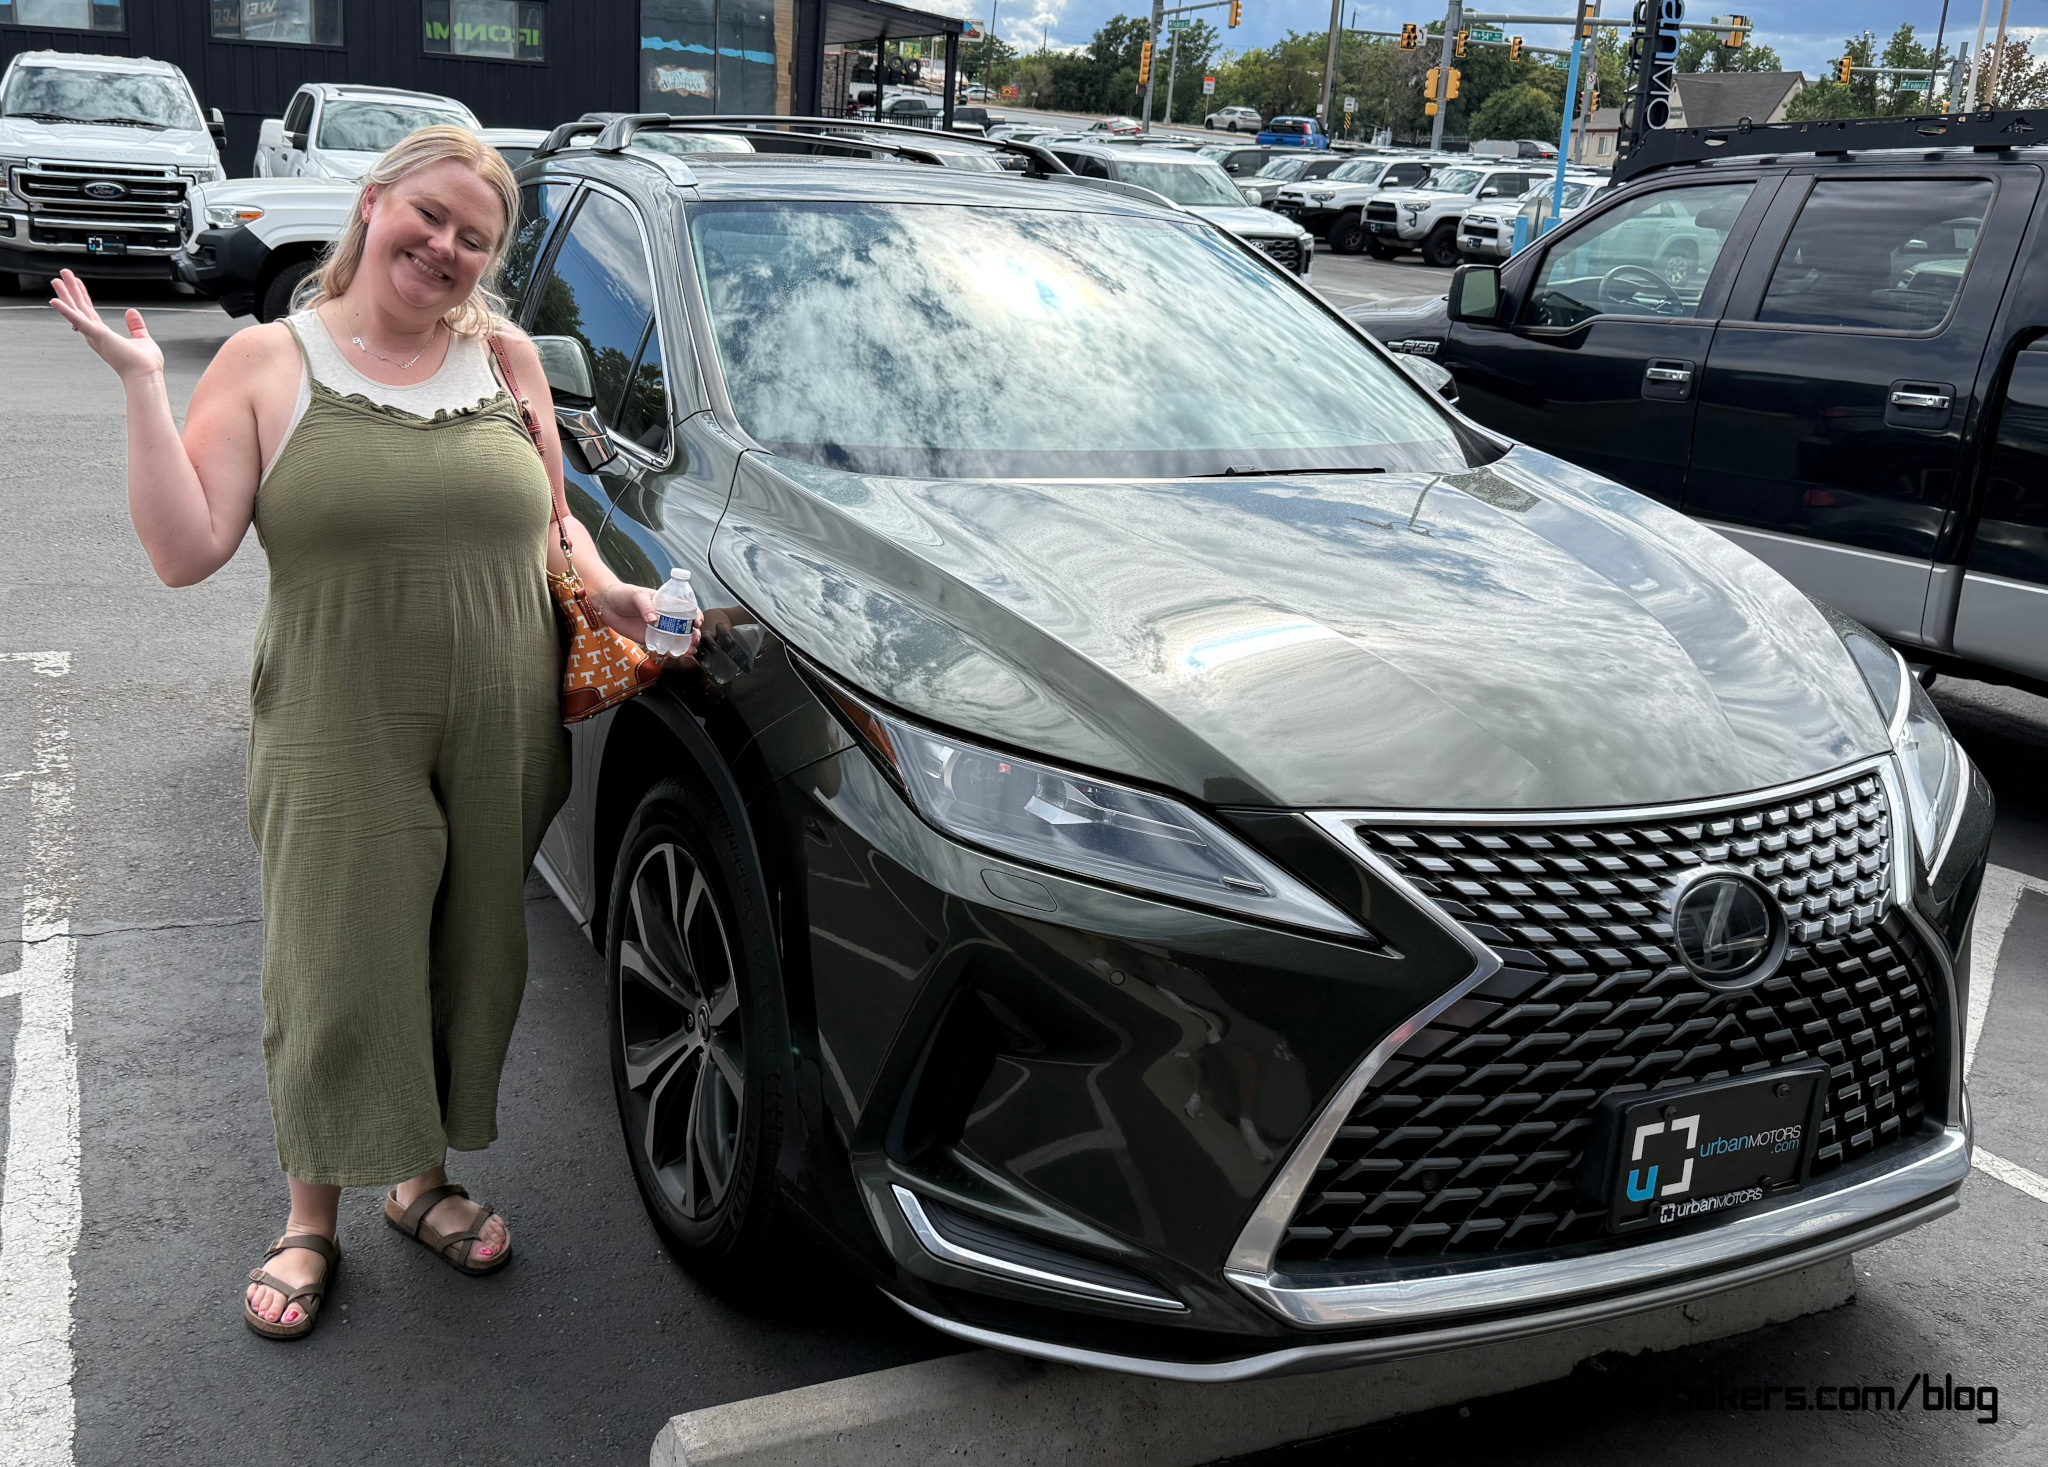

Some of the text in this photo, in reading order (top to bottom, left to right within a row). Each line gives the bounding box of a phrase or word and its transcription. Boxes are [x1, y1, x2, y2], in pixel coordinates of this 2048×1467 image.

[93, 185, 115, 196] Ford
[1701, 1125, 1802, 1157] urbanMOTORS
[1771, 1138, 1800, 1154] .com
[1677, 1187, 1763, 1217] urbanMOTORS
